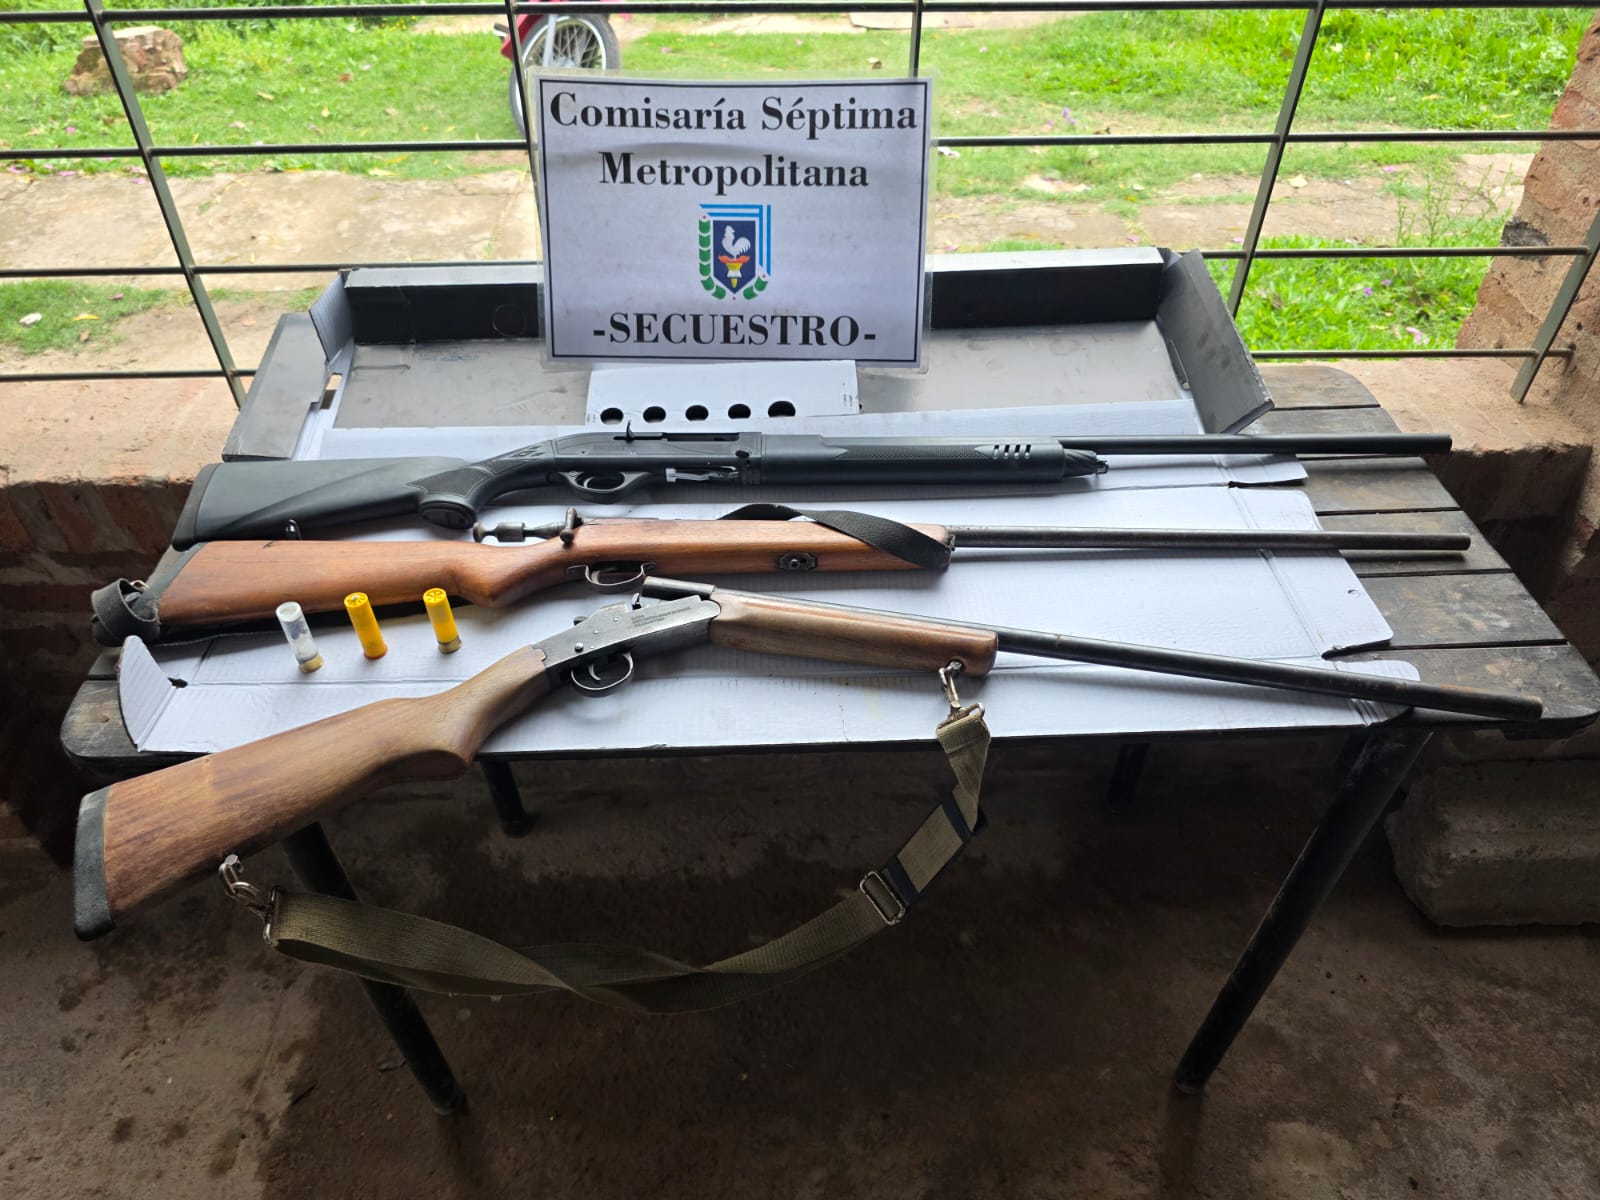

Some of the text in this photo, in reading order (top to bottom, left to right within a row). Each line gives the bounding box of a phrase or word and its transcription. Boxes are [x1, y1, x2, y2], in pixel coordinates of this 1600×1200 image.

[550, 92, 918, 140] Comisaría Séptima
[598, 151, 869, 196] Metropolitana
[592, 312, 877, 347] -SECUESTRO-
